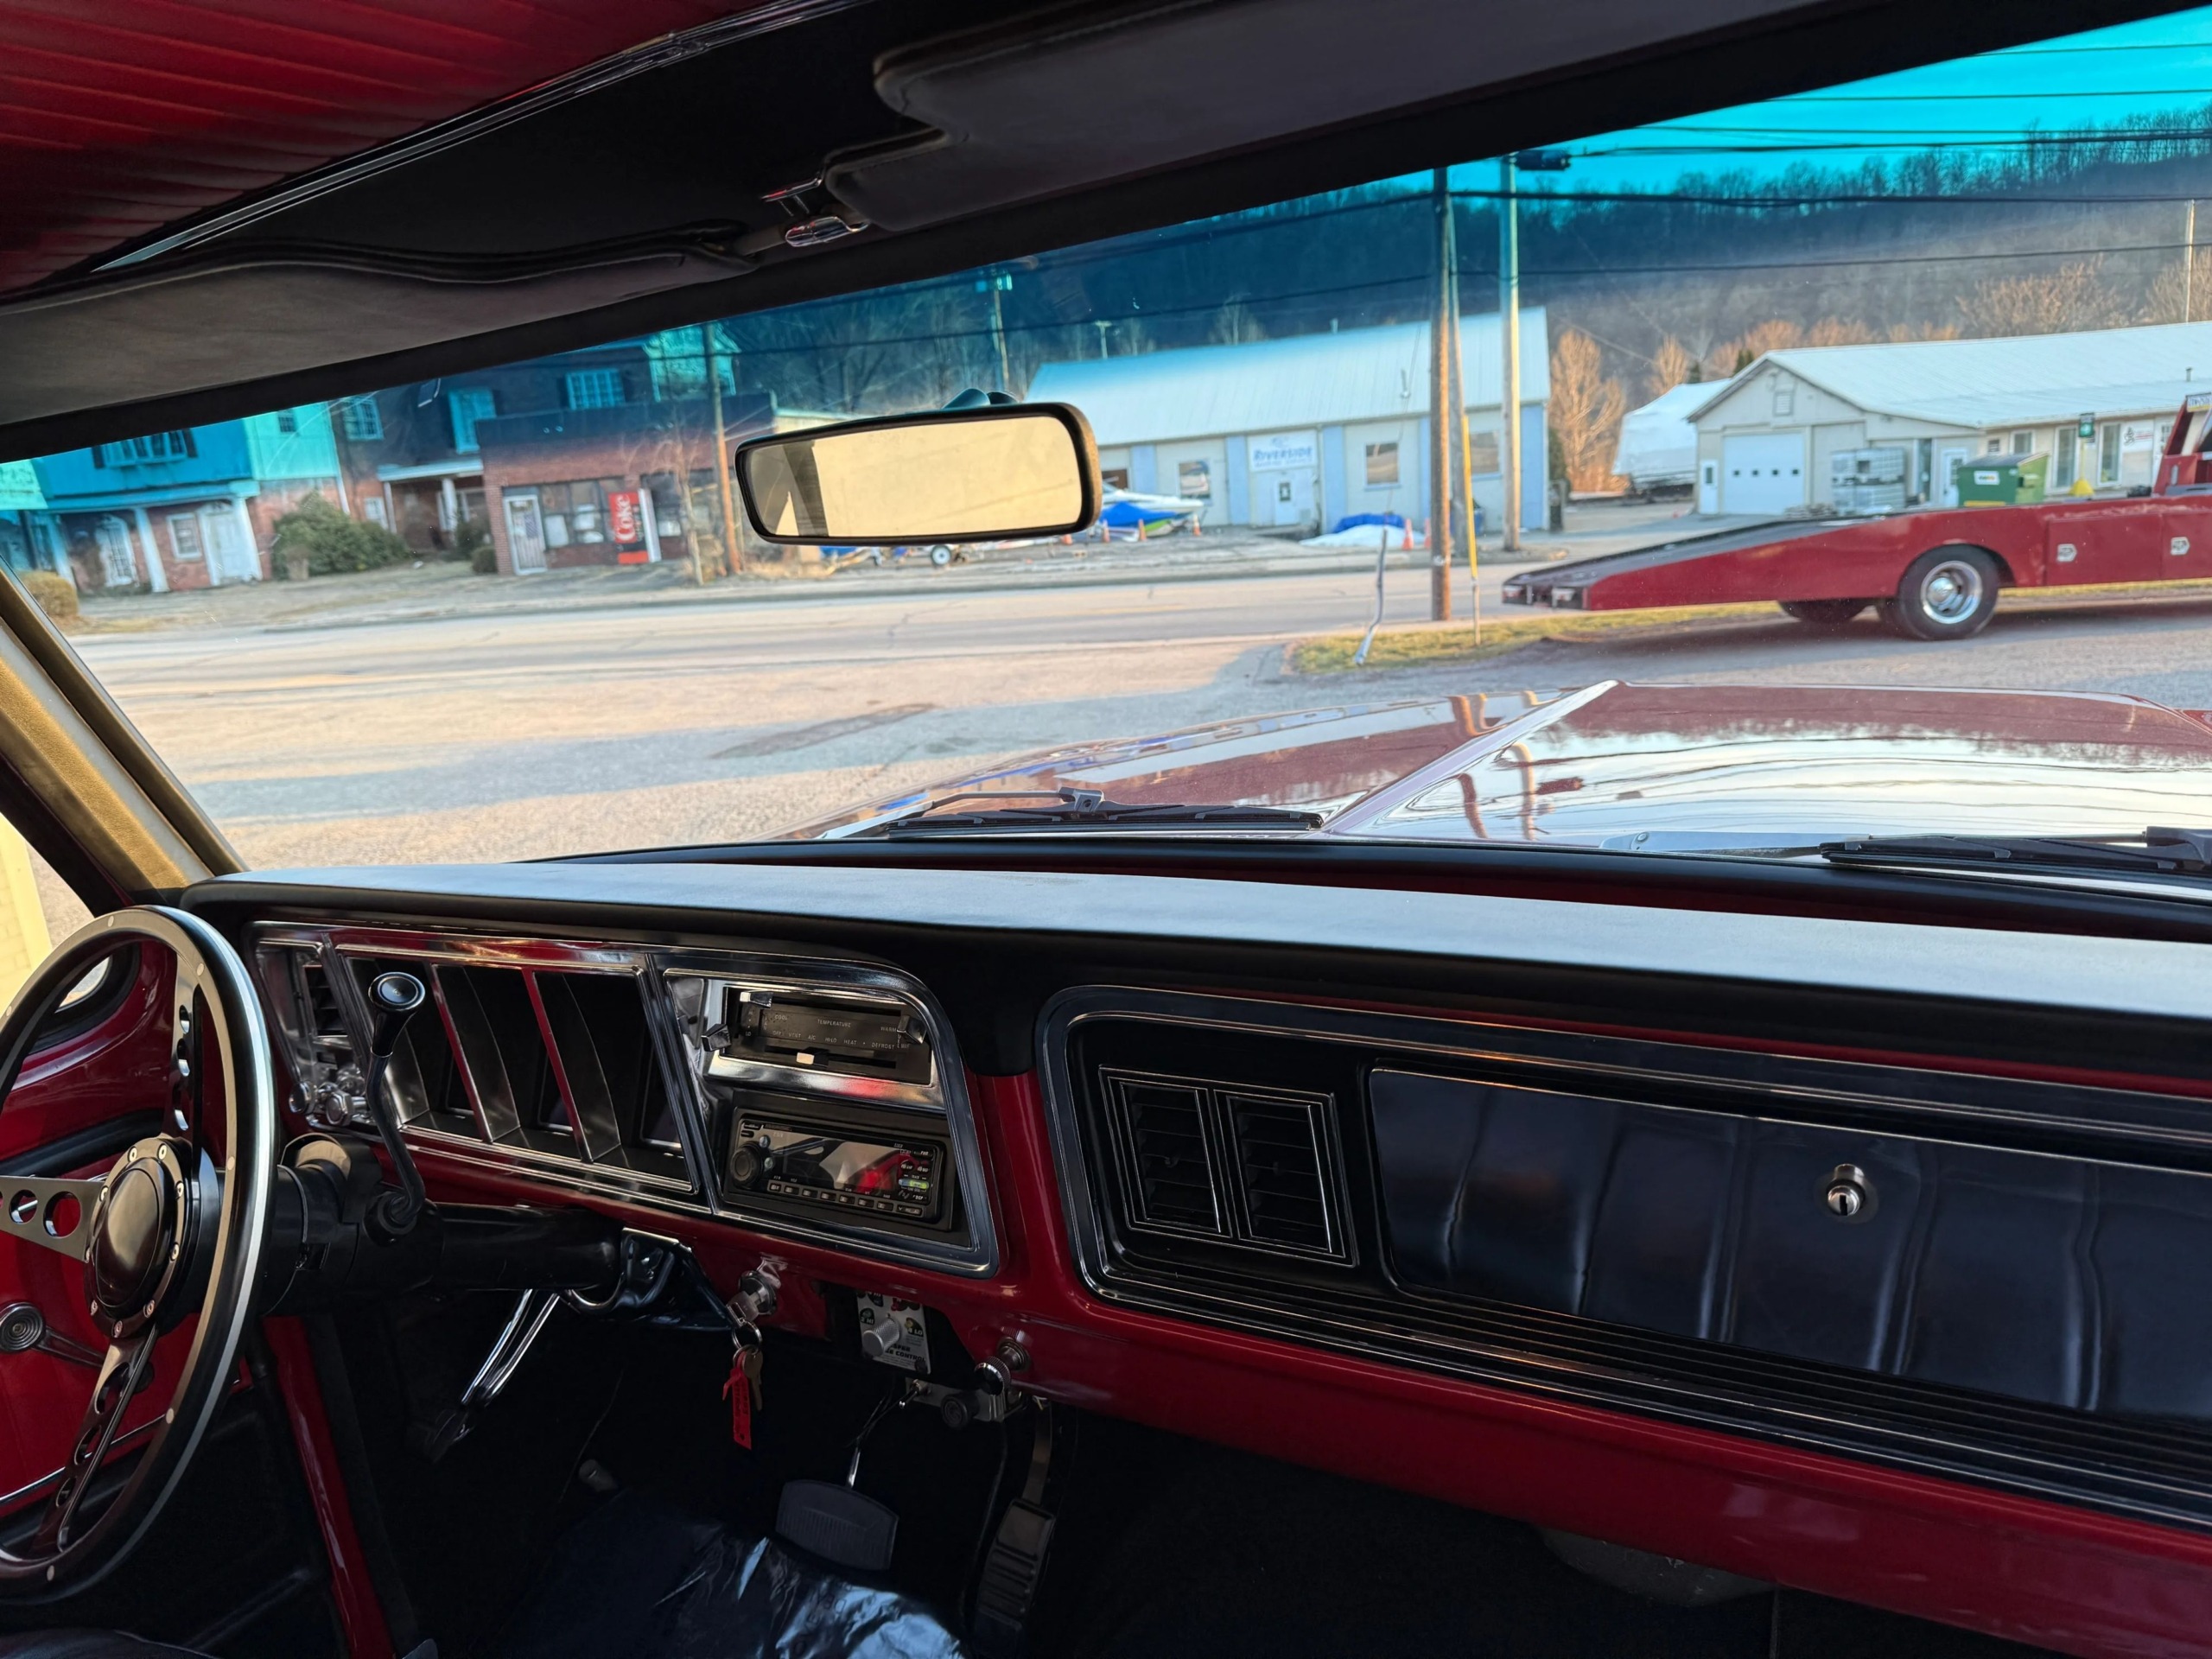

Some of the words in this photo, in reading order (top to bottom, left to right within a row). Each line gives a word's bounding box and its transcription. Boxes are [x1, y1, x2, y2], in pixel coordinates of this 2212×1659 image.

[614, 494, 636, 541] Coke
[817, 1019, 852, 1028] TEMPERATURE
[871, 1041, 895, 1050] DEFROST
[895, 1351, 926, 1362] CONTROL
